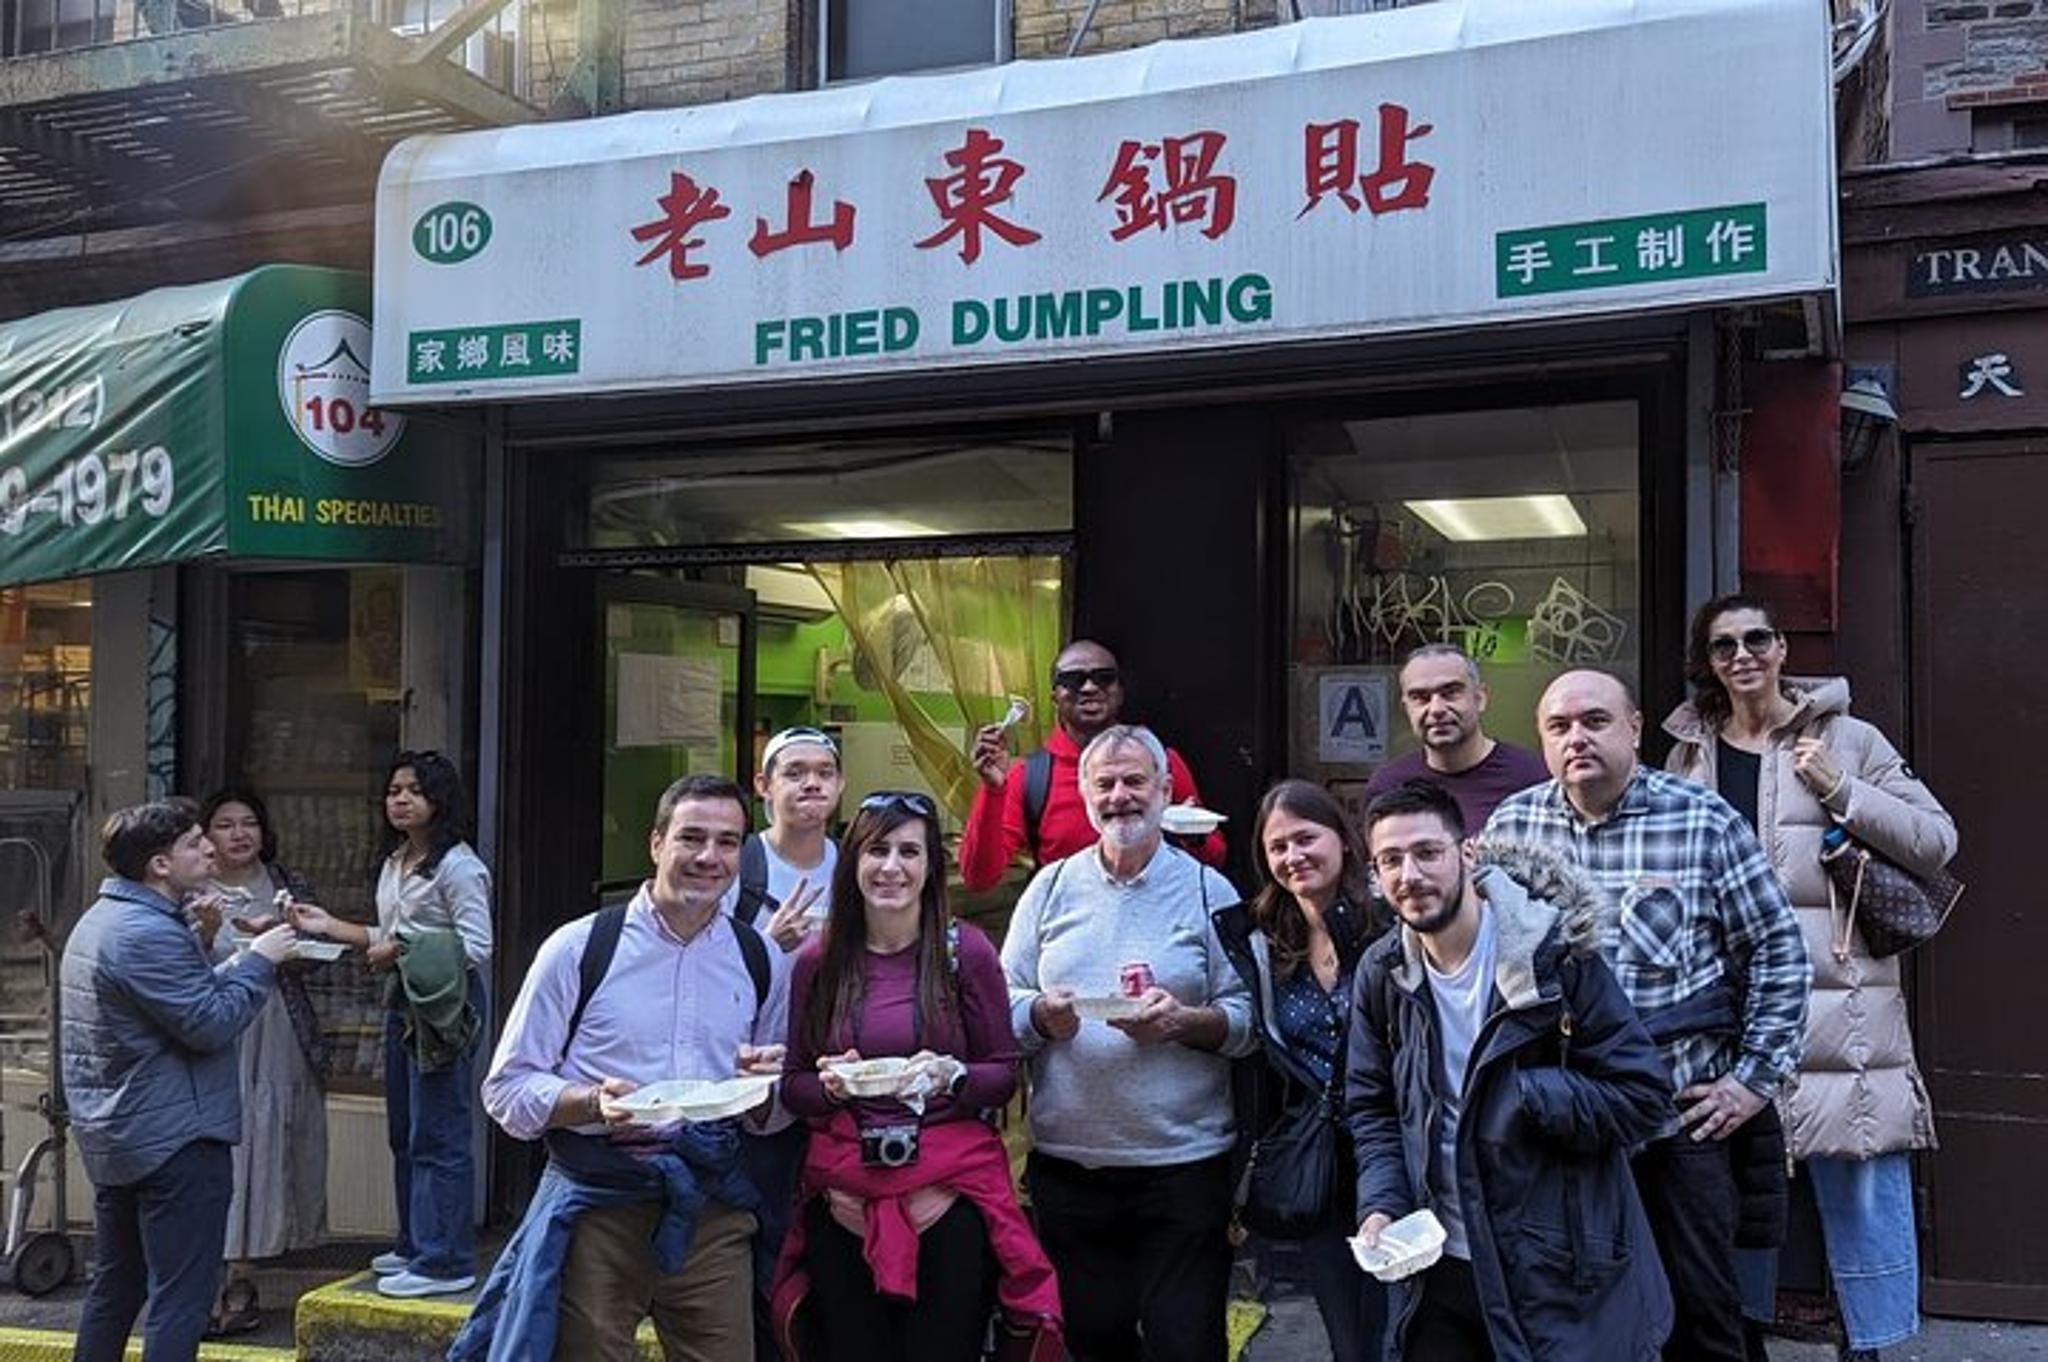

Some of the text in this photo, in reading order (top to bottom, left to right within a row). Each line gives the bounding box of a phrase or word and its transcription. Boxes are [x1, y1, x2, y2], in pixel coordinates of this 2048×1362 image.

[630, 102, 1436, 280] 老山東鍋貼
[423, 210, 481, 254] 106
[1506, 219, 1755, 284] 手工制作
[1916, 243, 2048, 284] TRAN
[755, 273, 1272, 364] FRIED DUMPLING
[415, 329, 574, 374] 家鄉風味
[1959, 353, 2025, 398] 天
[306, 395, 385, 437] 104
[248, 492, 442, 527] THAI SPECIALTIES
[1330, 685, 1378, 737] A
